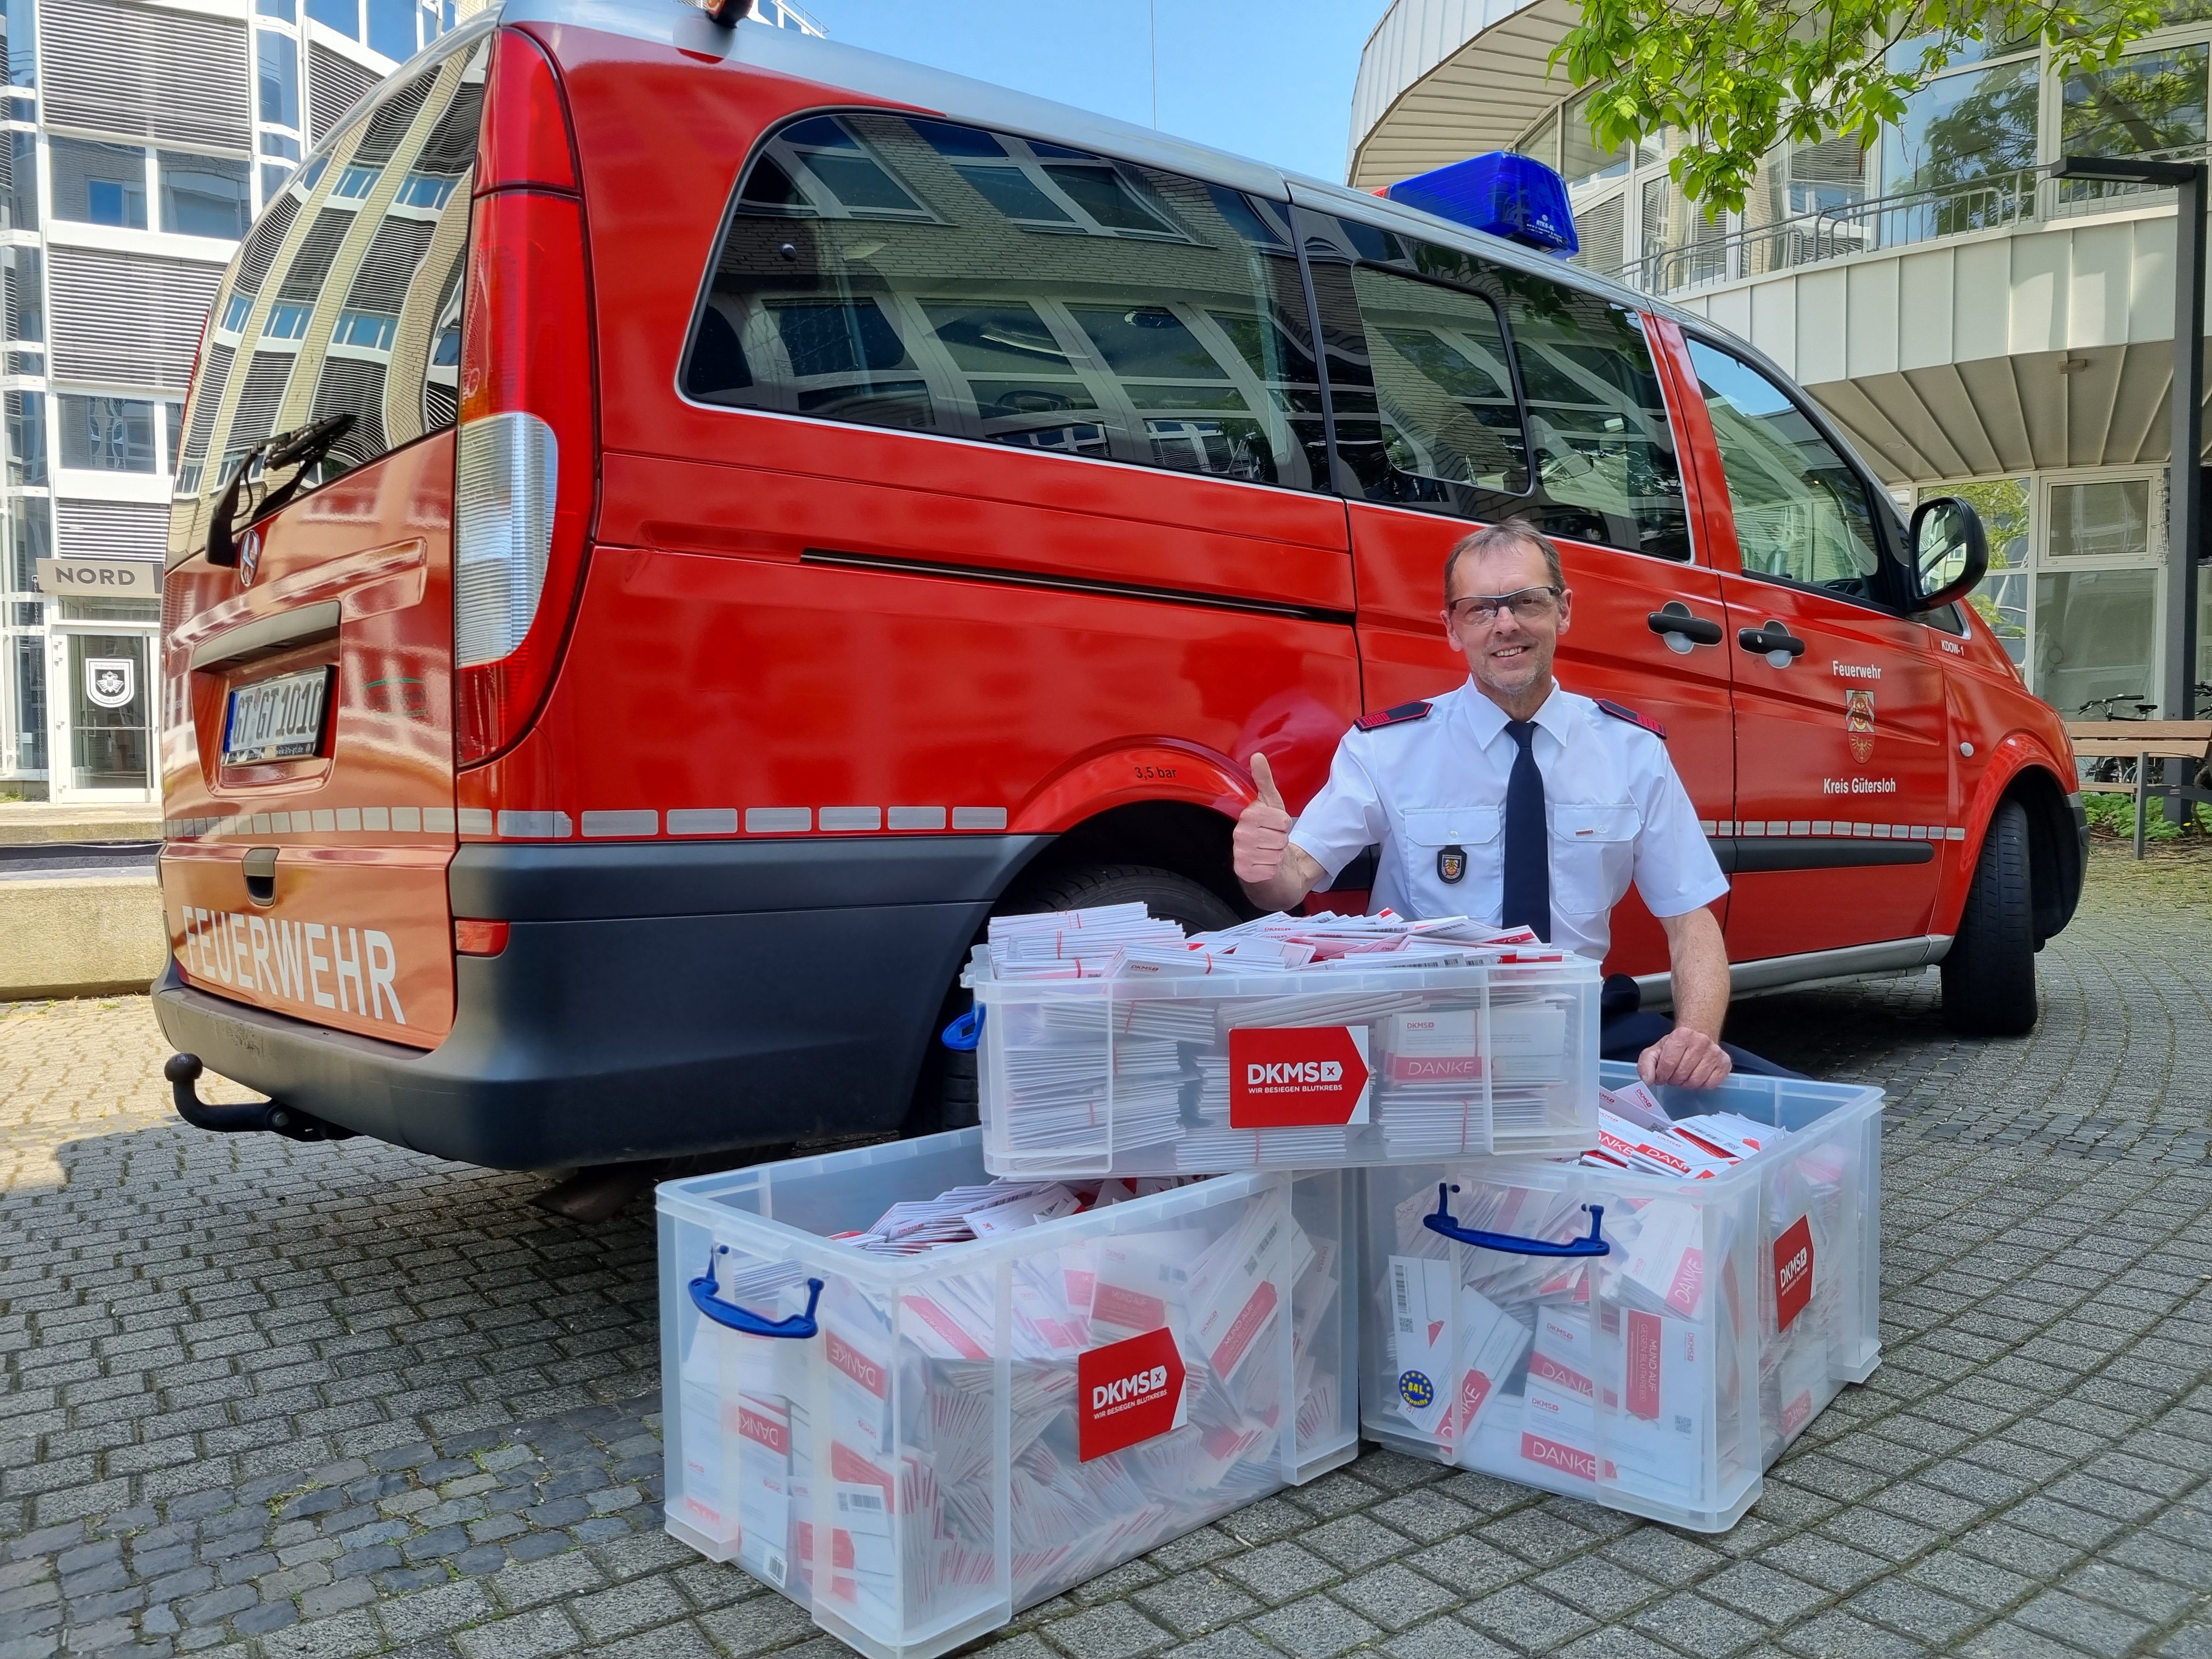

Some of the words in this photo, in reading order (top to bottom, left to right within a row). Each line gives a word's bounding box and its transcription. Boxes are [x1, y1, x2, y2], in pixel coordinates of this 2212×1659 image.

[55, 567, 136, 585] NORD
[1941, 639, 1965, 656] KDOW-1
[1832, 660, 1881, 679] Feuerwehr
[233, 694, 253, 744] GT
[256, 687, 280, 740] GT
[275, 679, 324, 736] 1010
[1134, 766, 1154, 780] 3,5
[1156, 766, 1177, 778] bar
[1824, 778, 1849, 794] Kreis
[1852, 776, 1896, 793] Gütersloh
[182, 905, 407, 1025] FEUERWEHR
[1248, 1062, 1321, 1085] DKMS
[1408, 1061, 1475, 1075] DANKE
[1636, 1088, 1649, 1105] DKMS
[1674, 1257, 1703, 1304] DANKE
[1780, 1253, 1801, 1289] DKMS
[1223, 1319, 1243, 1346] MUND
[1547, 1322, 1567, 1338] DKMS
[830, 1342, 876, 1387] DANKE
[1649, 1339, 1658, 1369] MUND
[1093, 1371, 1150, 1410] DKMS
[1542, 1362, 1593, 1396] DANK
[1648, 1372, 1657, 1392] AUF
[1093, 1410, 1106, 1420] WIR
[1107, 1400, 1136, 1416] BESIEGEN
[1137, 1389, 1167, 1406] BLUTKREBS
[1532, 1397, 1552, 1409] DKMS
[740, 1412, 778, 1446] DANK
[1533, 1441, 1596, 1476] DANKE
